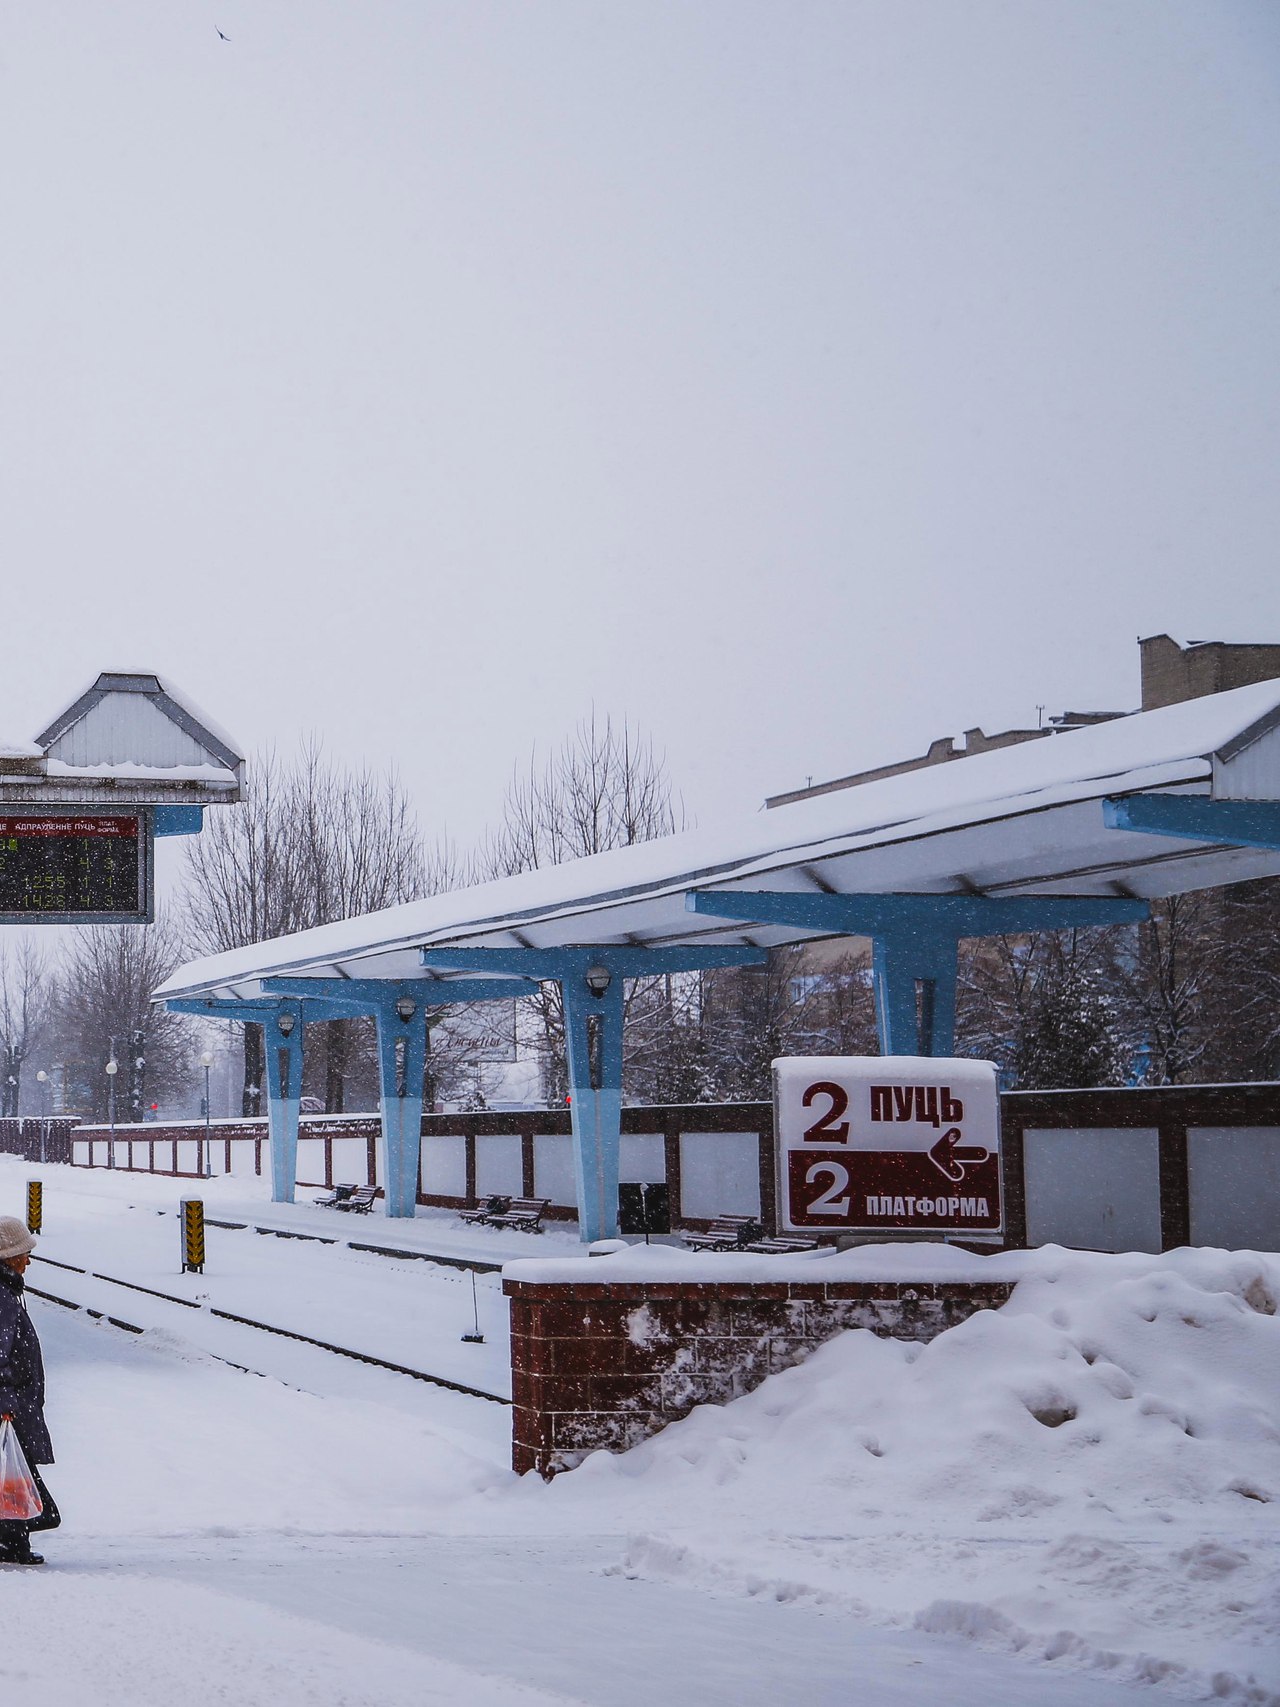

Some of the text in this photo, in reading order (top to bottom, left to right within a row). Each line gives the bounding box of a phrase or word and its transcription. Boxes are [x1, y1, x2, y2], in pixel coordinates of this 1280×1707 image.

[74, 822, 96, 832] ПУЦЬ
[80, 857, 90, 870] 4
[22, 875, 67, 889] 1255
[80, 894, 90, 908] 4
[802, 1081, 964, 1145] 2 ПУЦЬ
[805, 1161, 990, 1217] 2 ПЛАТФОРМА
